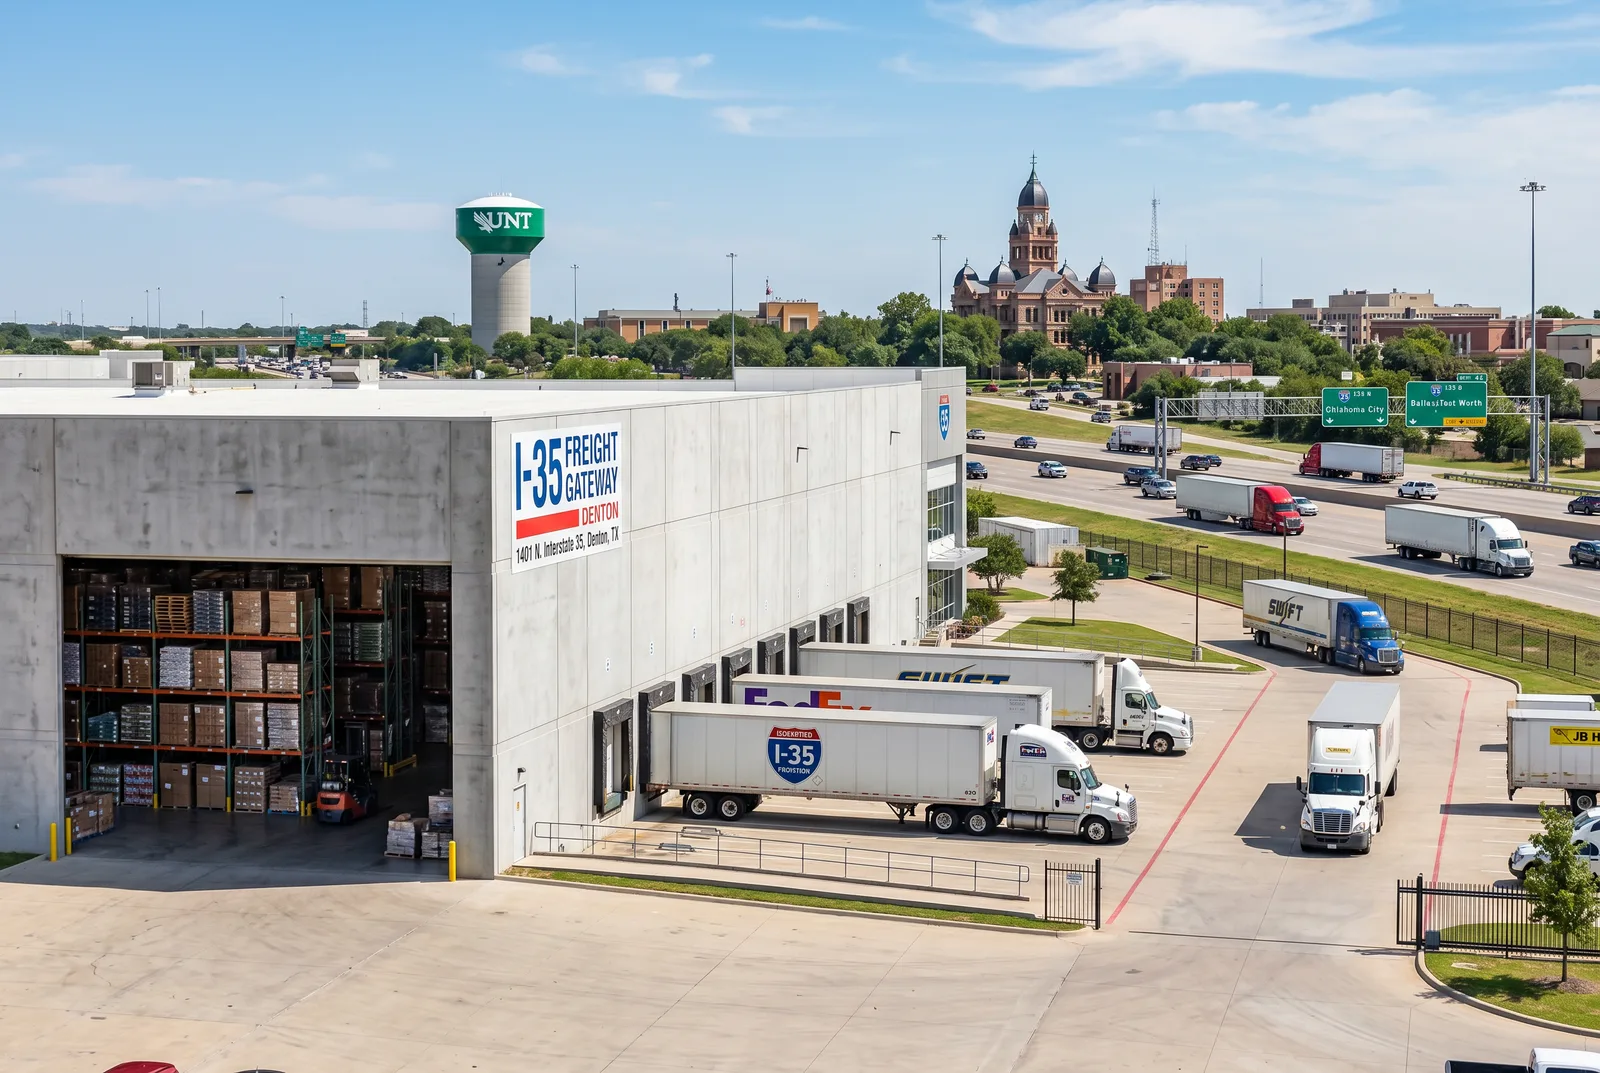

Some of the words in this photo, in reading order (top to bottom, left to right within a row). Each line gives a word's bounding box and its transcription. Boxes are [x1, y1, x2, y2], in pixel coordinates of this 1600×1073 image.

[486, 211, 532, 229] UNT
[1368, 406, 1384, 415] City
[1459, 399, 1483, 407] Worth
[565, 431, 618, 468] FREIGHT
[515, 437, 563, 511] I-35
[565, 466, 618, 502] GATEWAY
[582, 501, 619, 526] DENTON
[516, 545, 533, 564] 1401
[534, 543, 542, 560] N.
[543, 536, 575, 558] Interstate
[575, 533, 586, 551] 35,
[587, 530, 610, 548] Denton,
[611, 526, 619, 542] TX
[1268, 597, 1304, 622] SWIFT
[1573, 731, 1588, 742] JB
[775, 743, 815, 766] I-35
